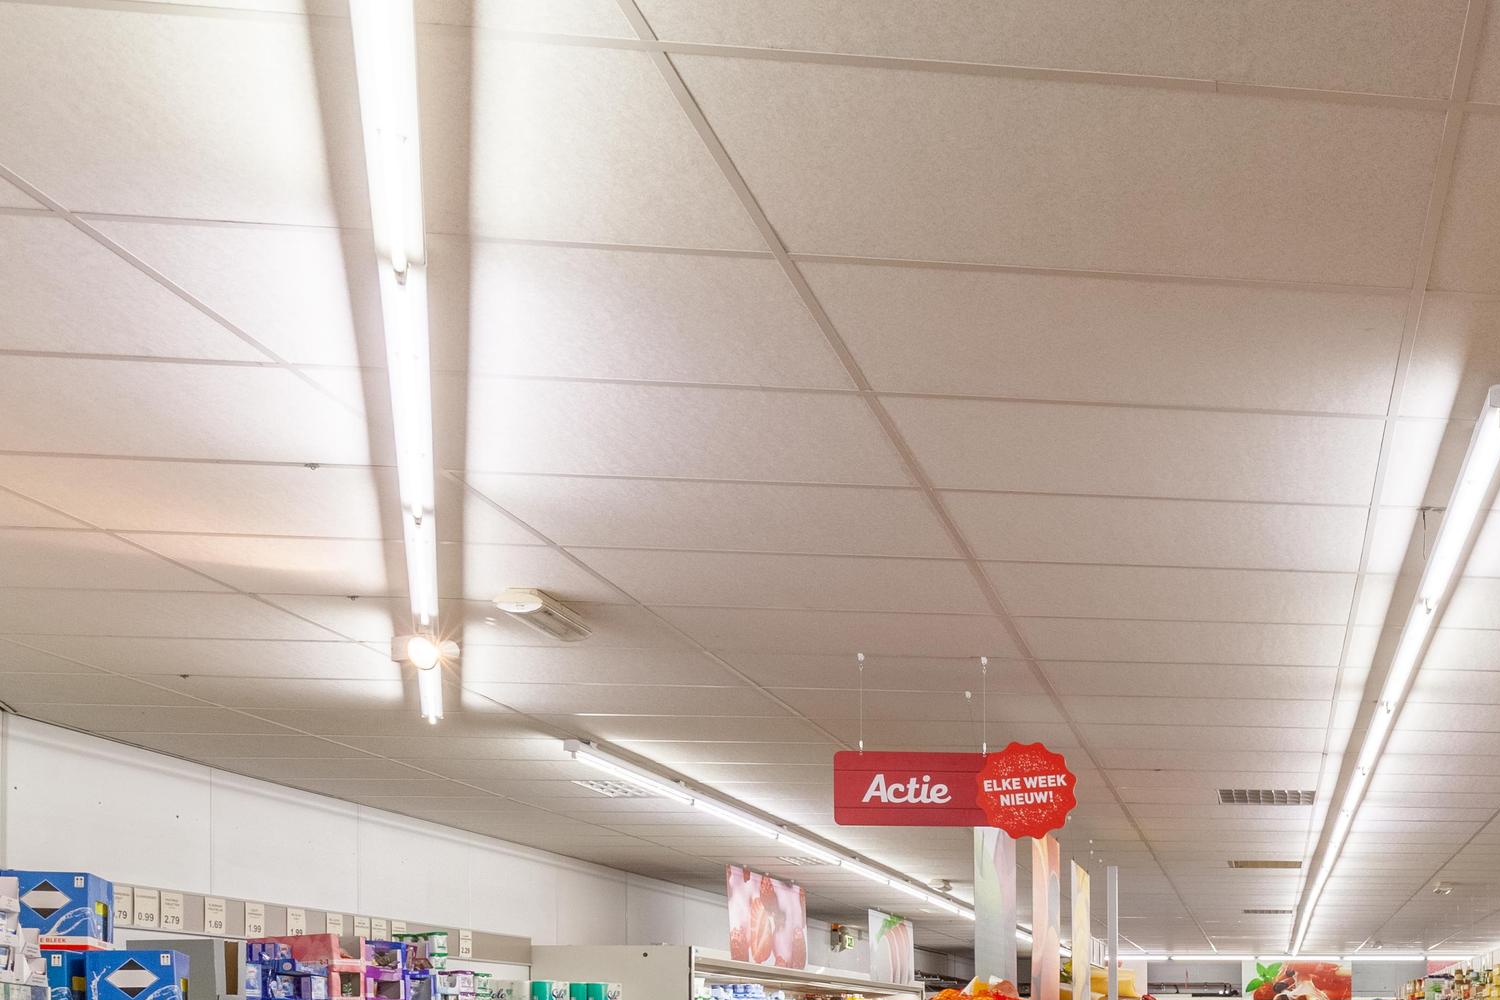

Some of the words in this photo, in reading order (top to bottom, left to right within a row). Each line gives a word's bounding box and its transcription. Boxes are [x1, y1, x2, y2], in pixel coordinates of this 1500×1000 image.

[983, 777, 1022, 792] ELKE
[1023, 774, 1067, 789] WEEK
[861, 773, 952, 804] Actie
[1000, 791, 1054, 806] NIEUW!
[114, 910, 128, 919] .79
[138, 911, 155, 922] 0.99
[164, 914, 180, 924] 2.79
[208, 920, 223, 929] 1.69
[248, 924, 262, 933] 1.99
